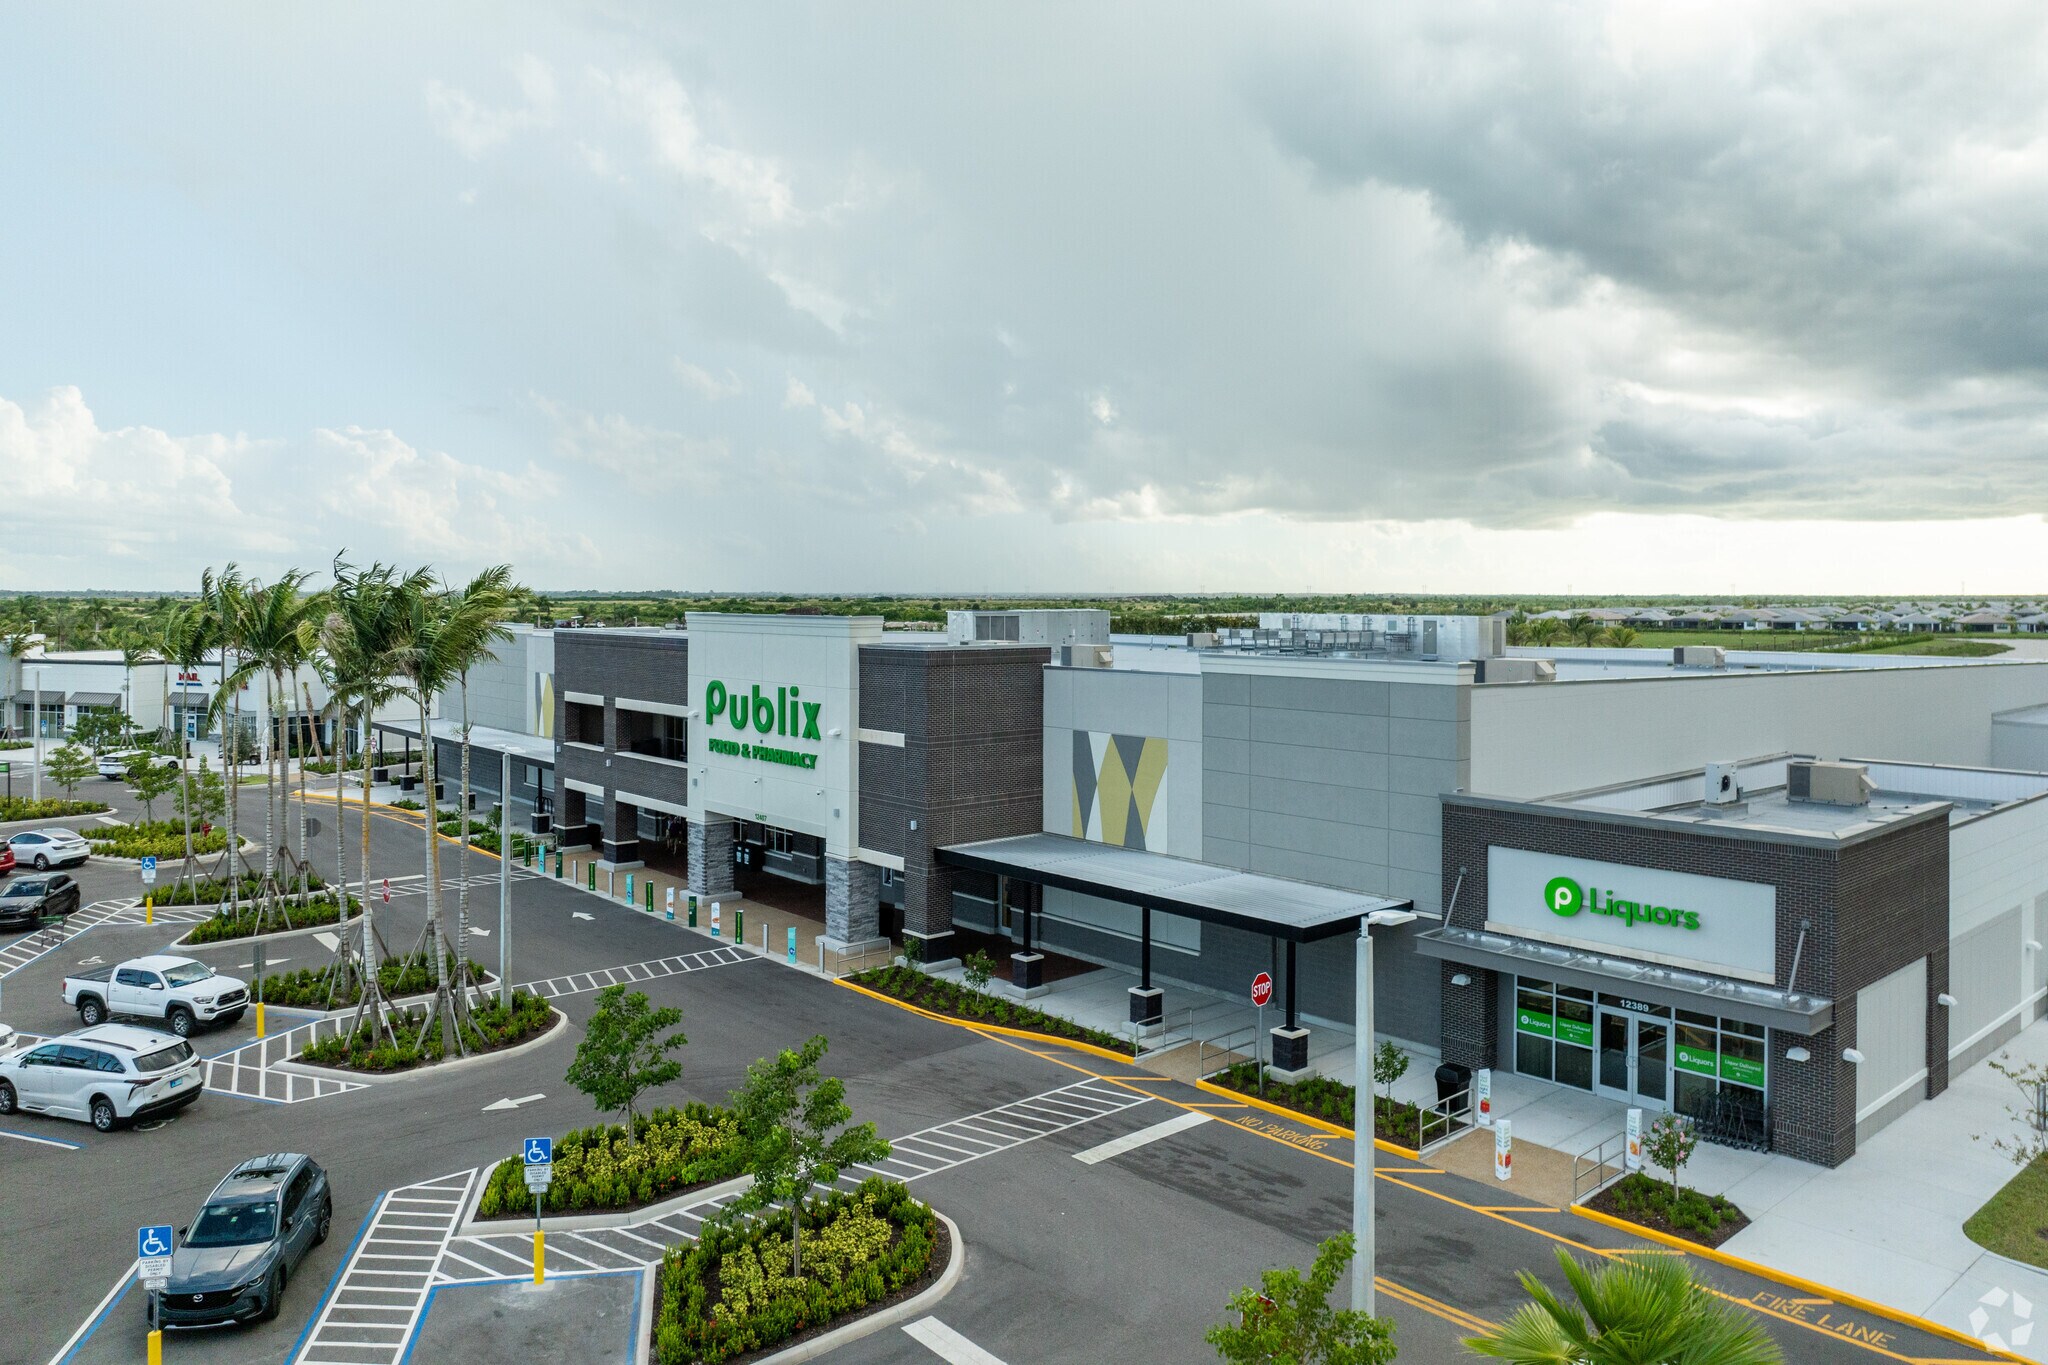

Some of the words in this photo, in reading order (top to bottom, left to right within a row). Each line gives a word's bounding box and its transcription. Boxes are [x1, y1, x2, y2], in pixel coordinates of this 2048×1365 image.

[706, 680, 821, 741] Publix
[709, 738, 740, 756] FOOD
[741, 743, 752, 759] &
[752, 745, 818, 769] PHARMACY
[1589, 887, 1700, 931] Liquors
[1253, 981, 1271, 998] STOP
[1620, 999, 1649, 1013] 12389
[1529, 1018, 1551, 1029] Liquors
[1689, 1055, 1714, 1067] Liquors
[1236, 1116, 1263, 1127] NO
[1259, 1123, 1328, 1150] PARKING
[1751, 1291, 1815, 1321] FIRE
[1817, 1314, 1896, 1349] LANE
